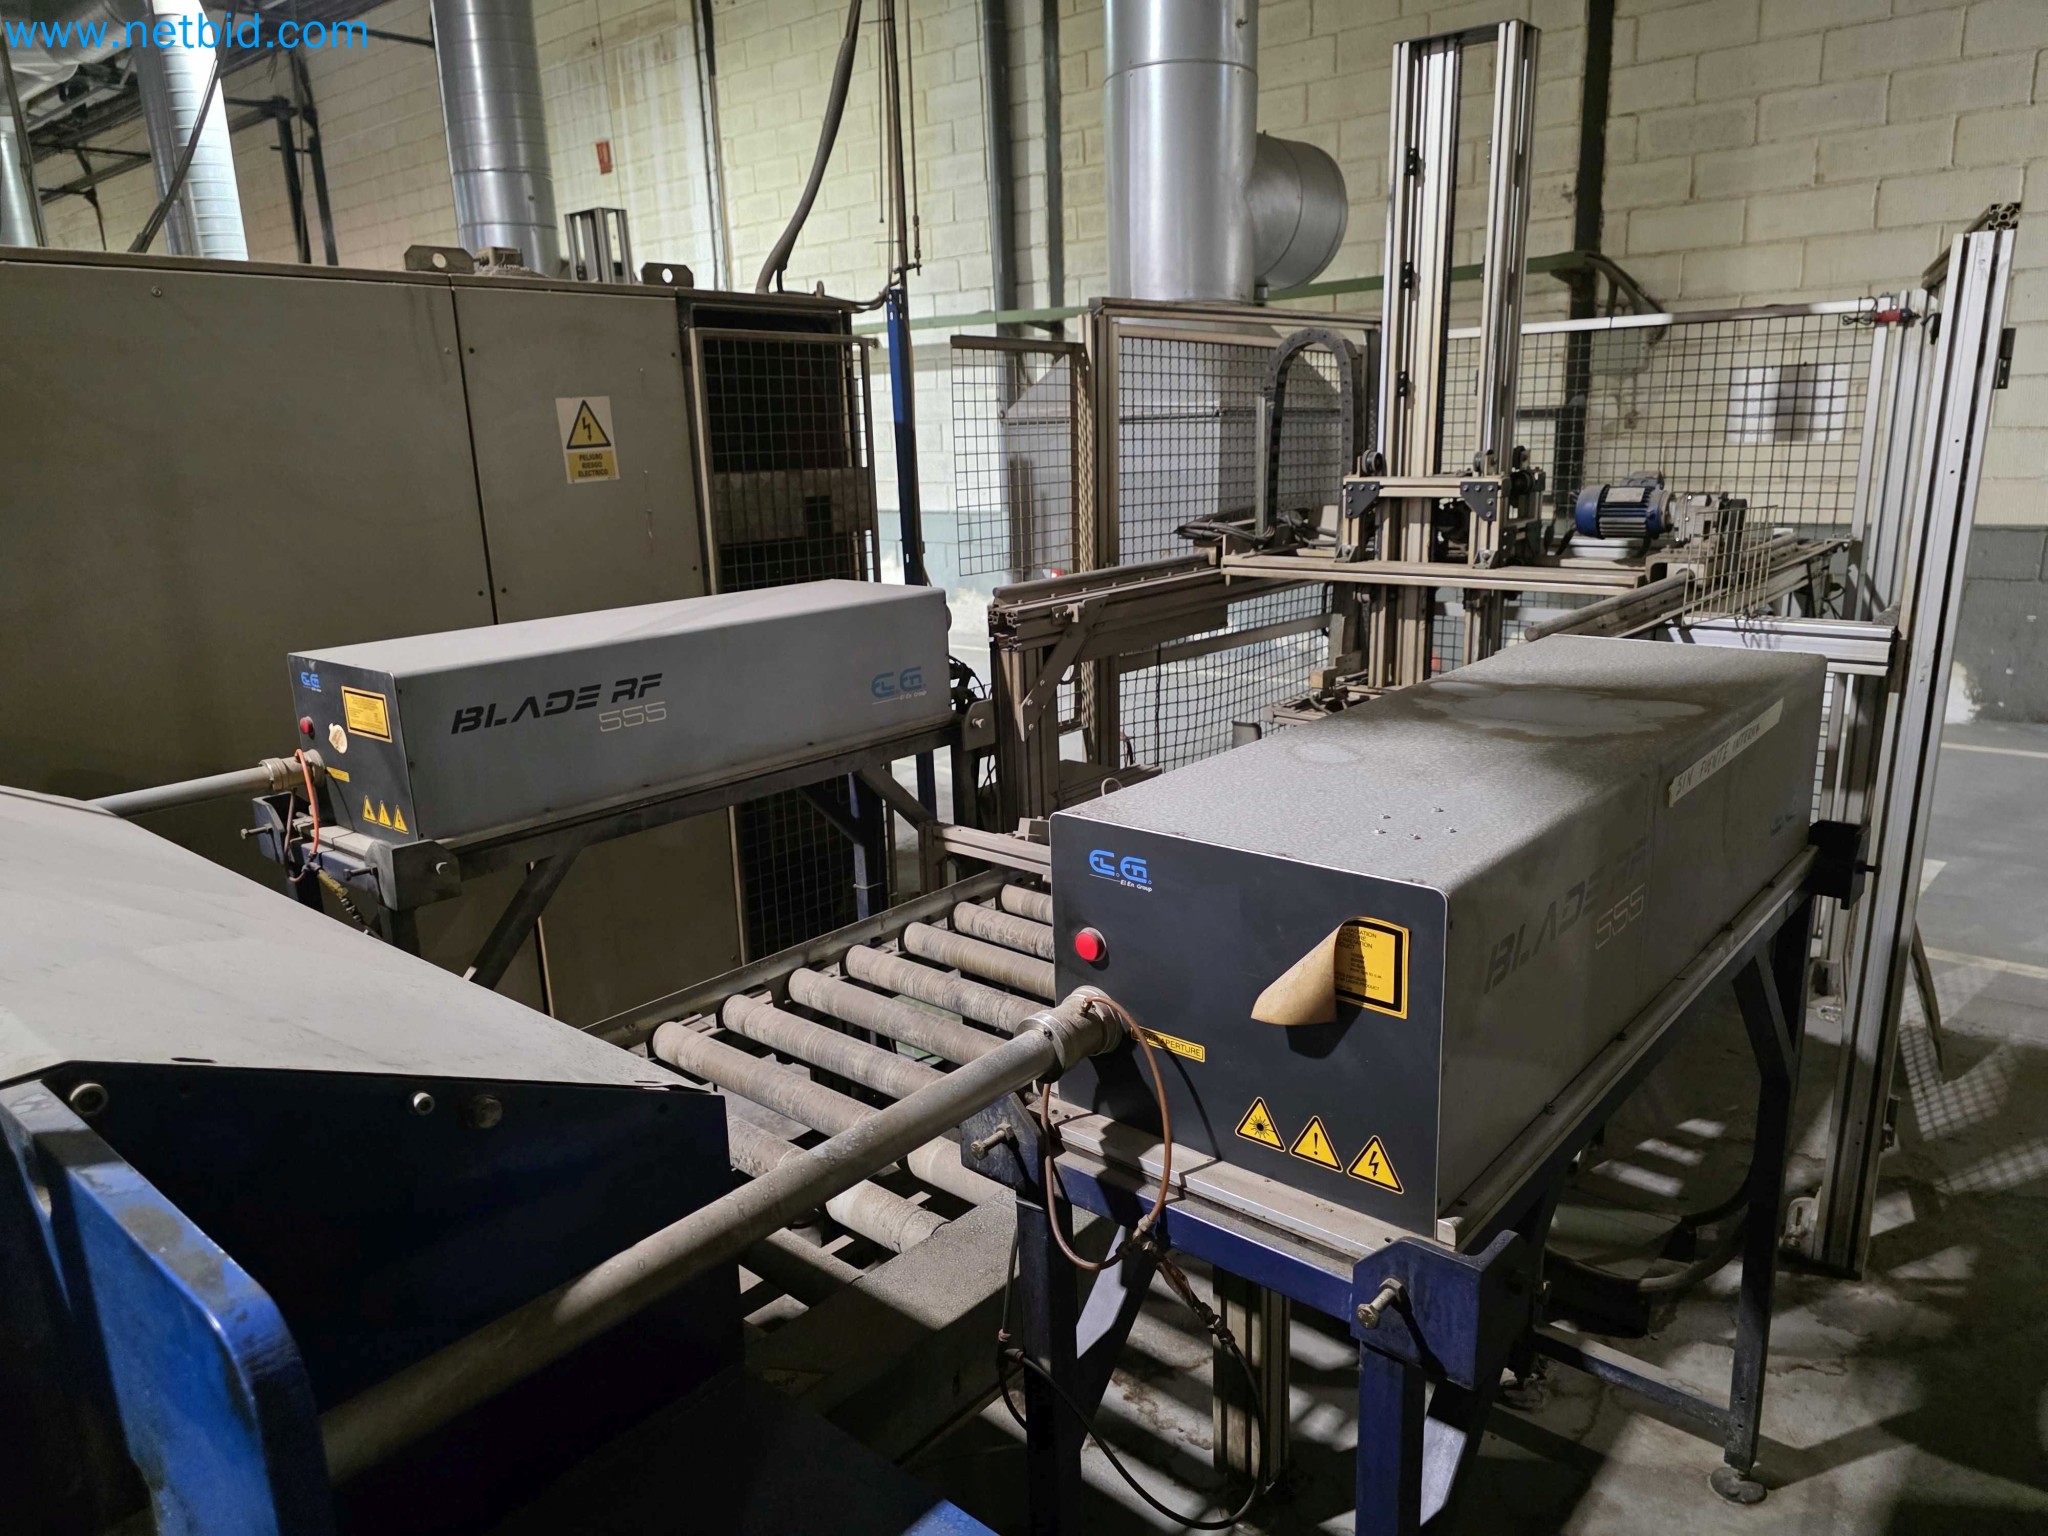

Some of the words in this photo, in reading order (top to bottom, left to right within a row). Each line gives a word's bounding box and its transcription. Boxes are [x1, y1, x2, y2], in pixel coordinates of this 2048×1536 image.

[579, 453, 603, 461] PELIGRO
[582, 461, 603, 469] RIESGO
[451, 684, 601, 734] BLADE
[611, 673, 663, 703] RF
[599, 701, 667, 732] 555
[1676, 767, 1695, 797] SIN
[1483, 862, 1607, 995] BLADE
[1595, 882, 1646, 950] 555
[1160, 1037, 1202, 1057] APERTURE
